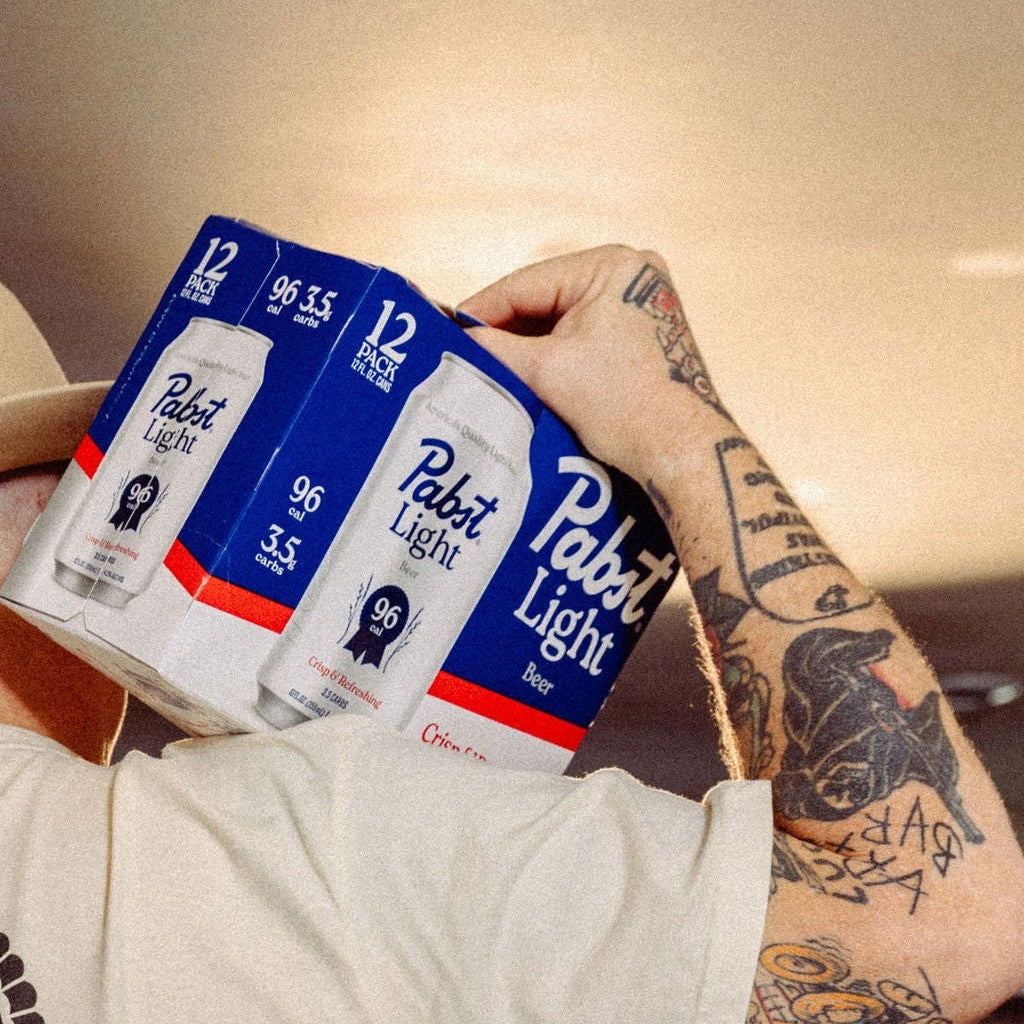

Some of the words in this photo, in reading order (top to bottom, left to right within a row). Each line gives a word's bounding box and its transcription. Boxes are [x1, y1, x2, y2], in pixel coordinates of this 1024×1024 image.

[193, 237, 239, 282] 12
[184, 274, 221, 296] PACK
[269, 275, 302, 305] 96
[266, 304, 283, 316] cal
[293, 313, 320, 329] carbs
[365, 300, 417, 364] 12
[350, 358, 361, 371] 12
[375, 375, 393, 393] CANS
[356, 341, 399, 382] PACK
[150, 373, 228, 430] Pabst
[143, 418, 197, 454] Light
[127, 483, 154, 503] 96
[289, 475, 325, 512] 96
[398, 438, 500, 539] Pabst
[288, 507, 306, 522] cal
[389, 501, 461, 570] Light
[529, 455, 676, 624] Pabst
[255, 553, 284, 576] carbs
[369, 624, 384, 636] cal
[371, 597, 402, 630] 96
[513, 566, 614, 676] Light
[308, 655, 330, 678] Crisp
[329, 671, 341, 682] &
[338, 675, 383, 711] Refreshing
[521, 661, 555, 696] Beer
